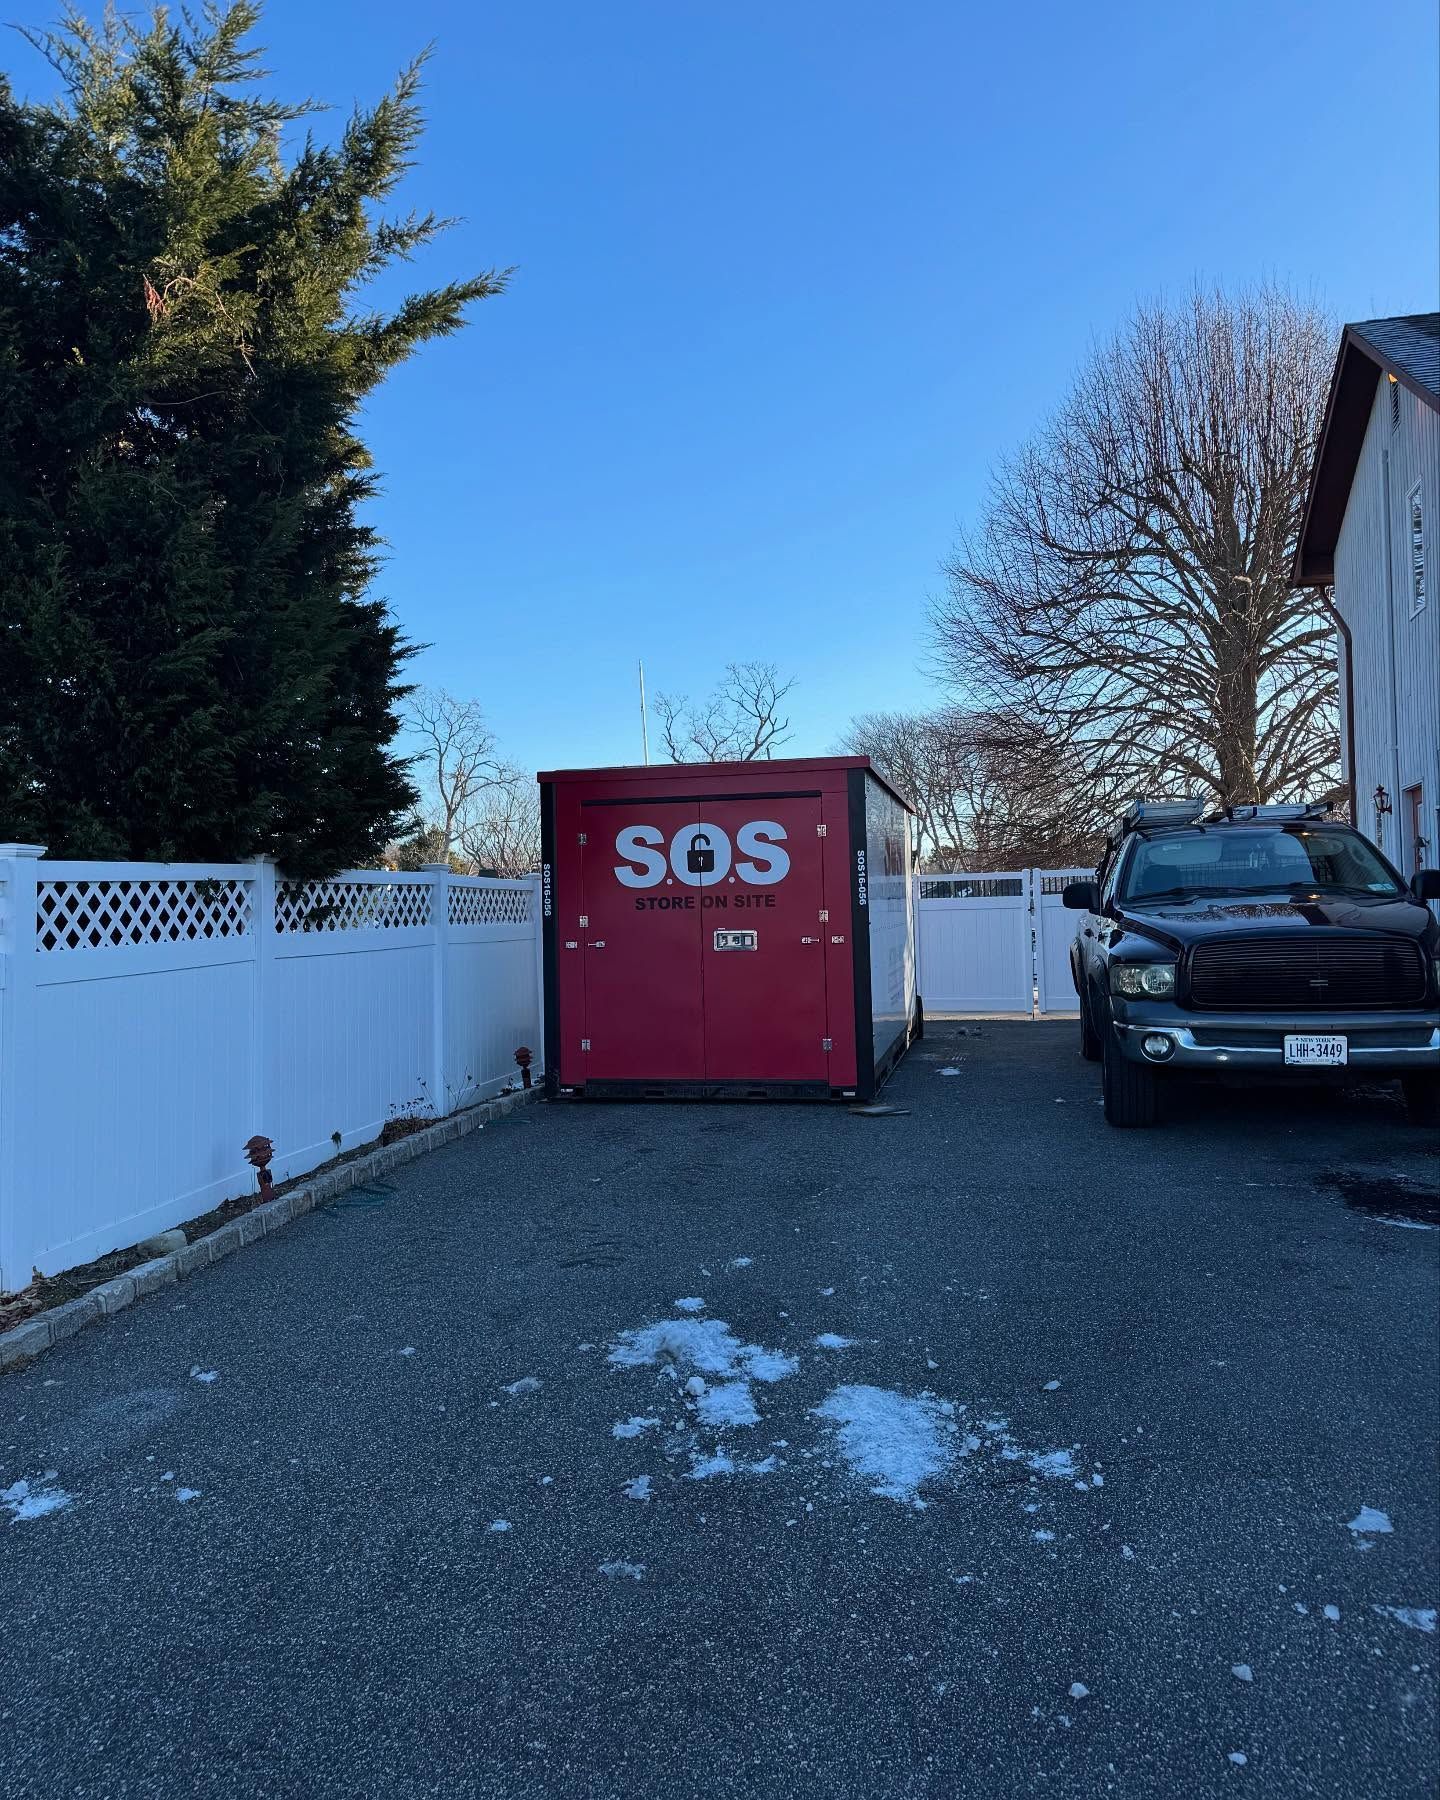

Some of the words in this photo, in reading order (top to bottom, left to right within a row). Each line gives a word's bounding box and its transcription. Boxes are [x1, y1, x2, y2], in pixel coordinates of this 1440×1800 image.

[614, 820, 791, 889] S.O.S
[857, 850, 867, 906] SOS16-056
[543, 863, 552, 917] SOS16-056
[635, 896, 695, 911] STORE
[701, 895, 728, 909] ON
[734, 894, 777, 908] SITE
